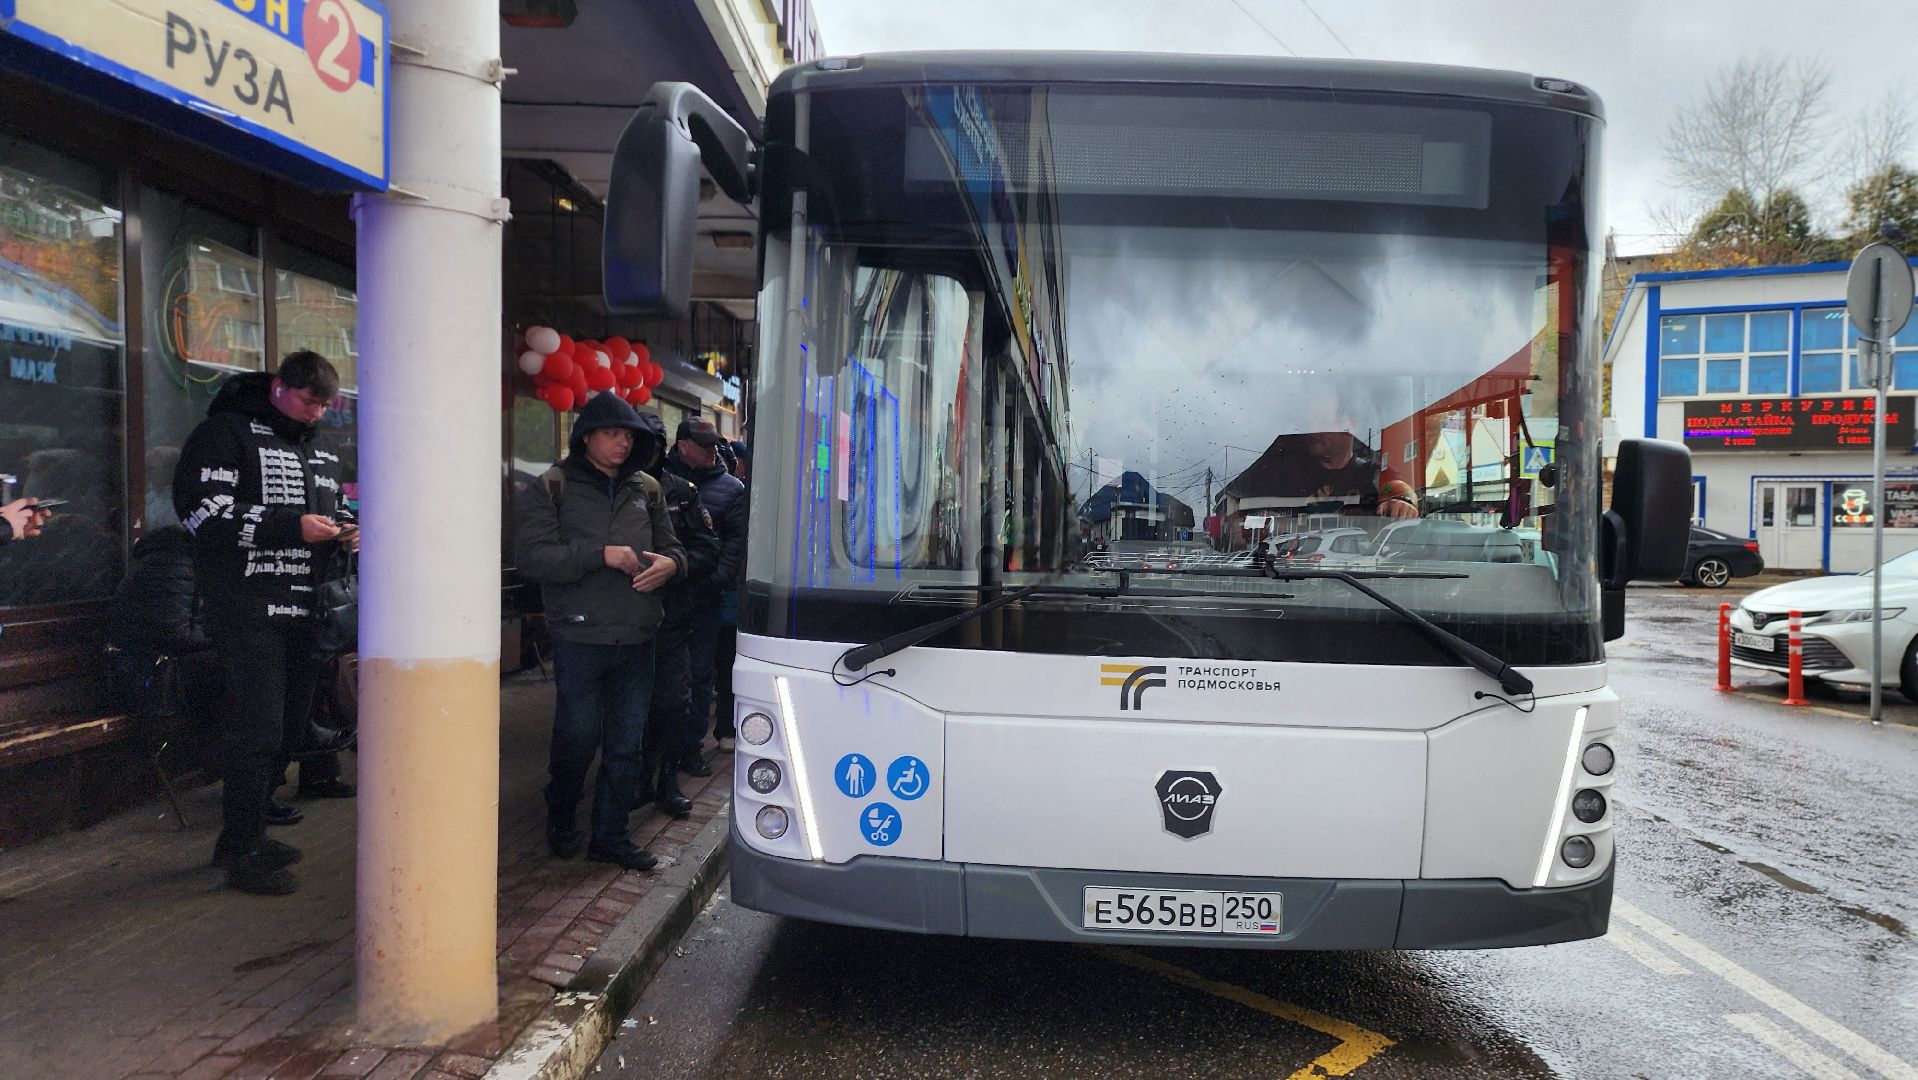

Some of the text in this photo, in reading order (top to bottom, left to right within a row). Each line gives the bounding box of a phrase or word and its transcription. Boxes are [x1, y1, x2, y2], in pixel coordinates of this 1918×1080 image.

[317, 0, 350, 83] 2
[166, 11, 294, 124] РУЗА
[1178, 666, 1257, 678] ТРАНСПОРТ
[1178, 679, 1281, 692] ПОДМОСКОВЬЯ
[1163, 793, 1215, 805] ЛИАЗ
[1095, 893, 1272, 928] Е565ВВ 250
[1236, 921, 1259, 930] RUS
